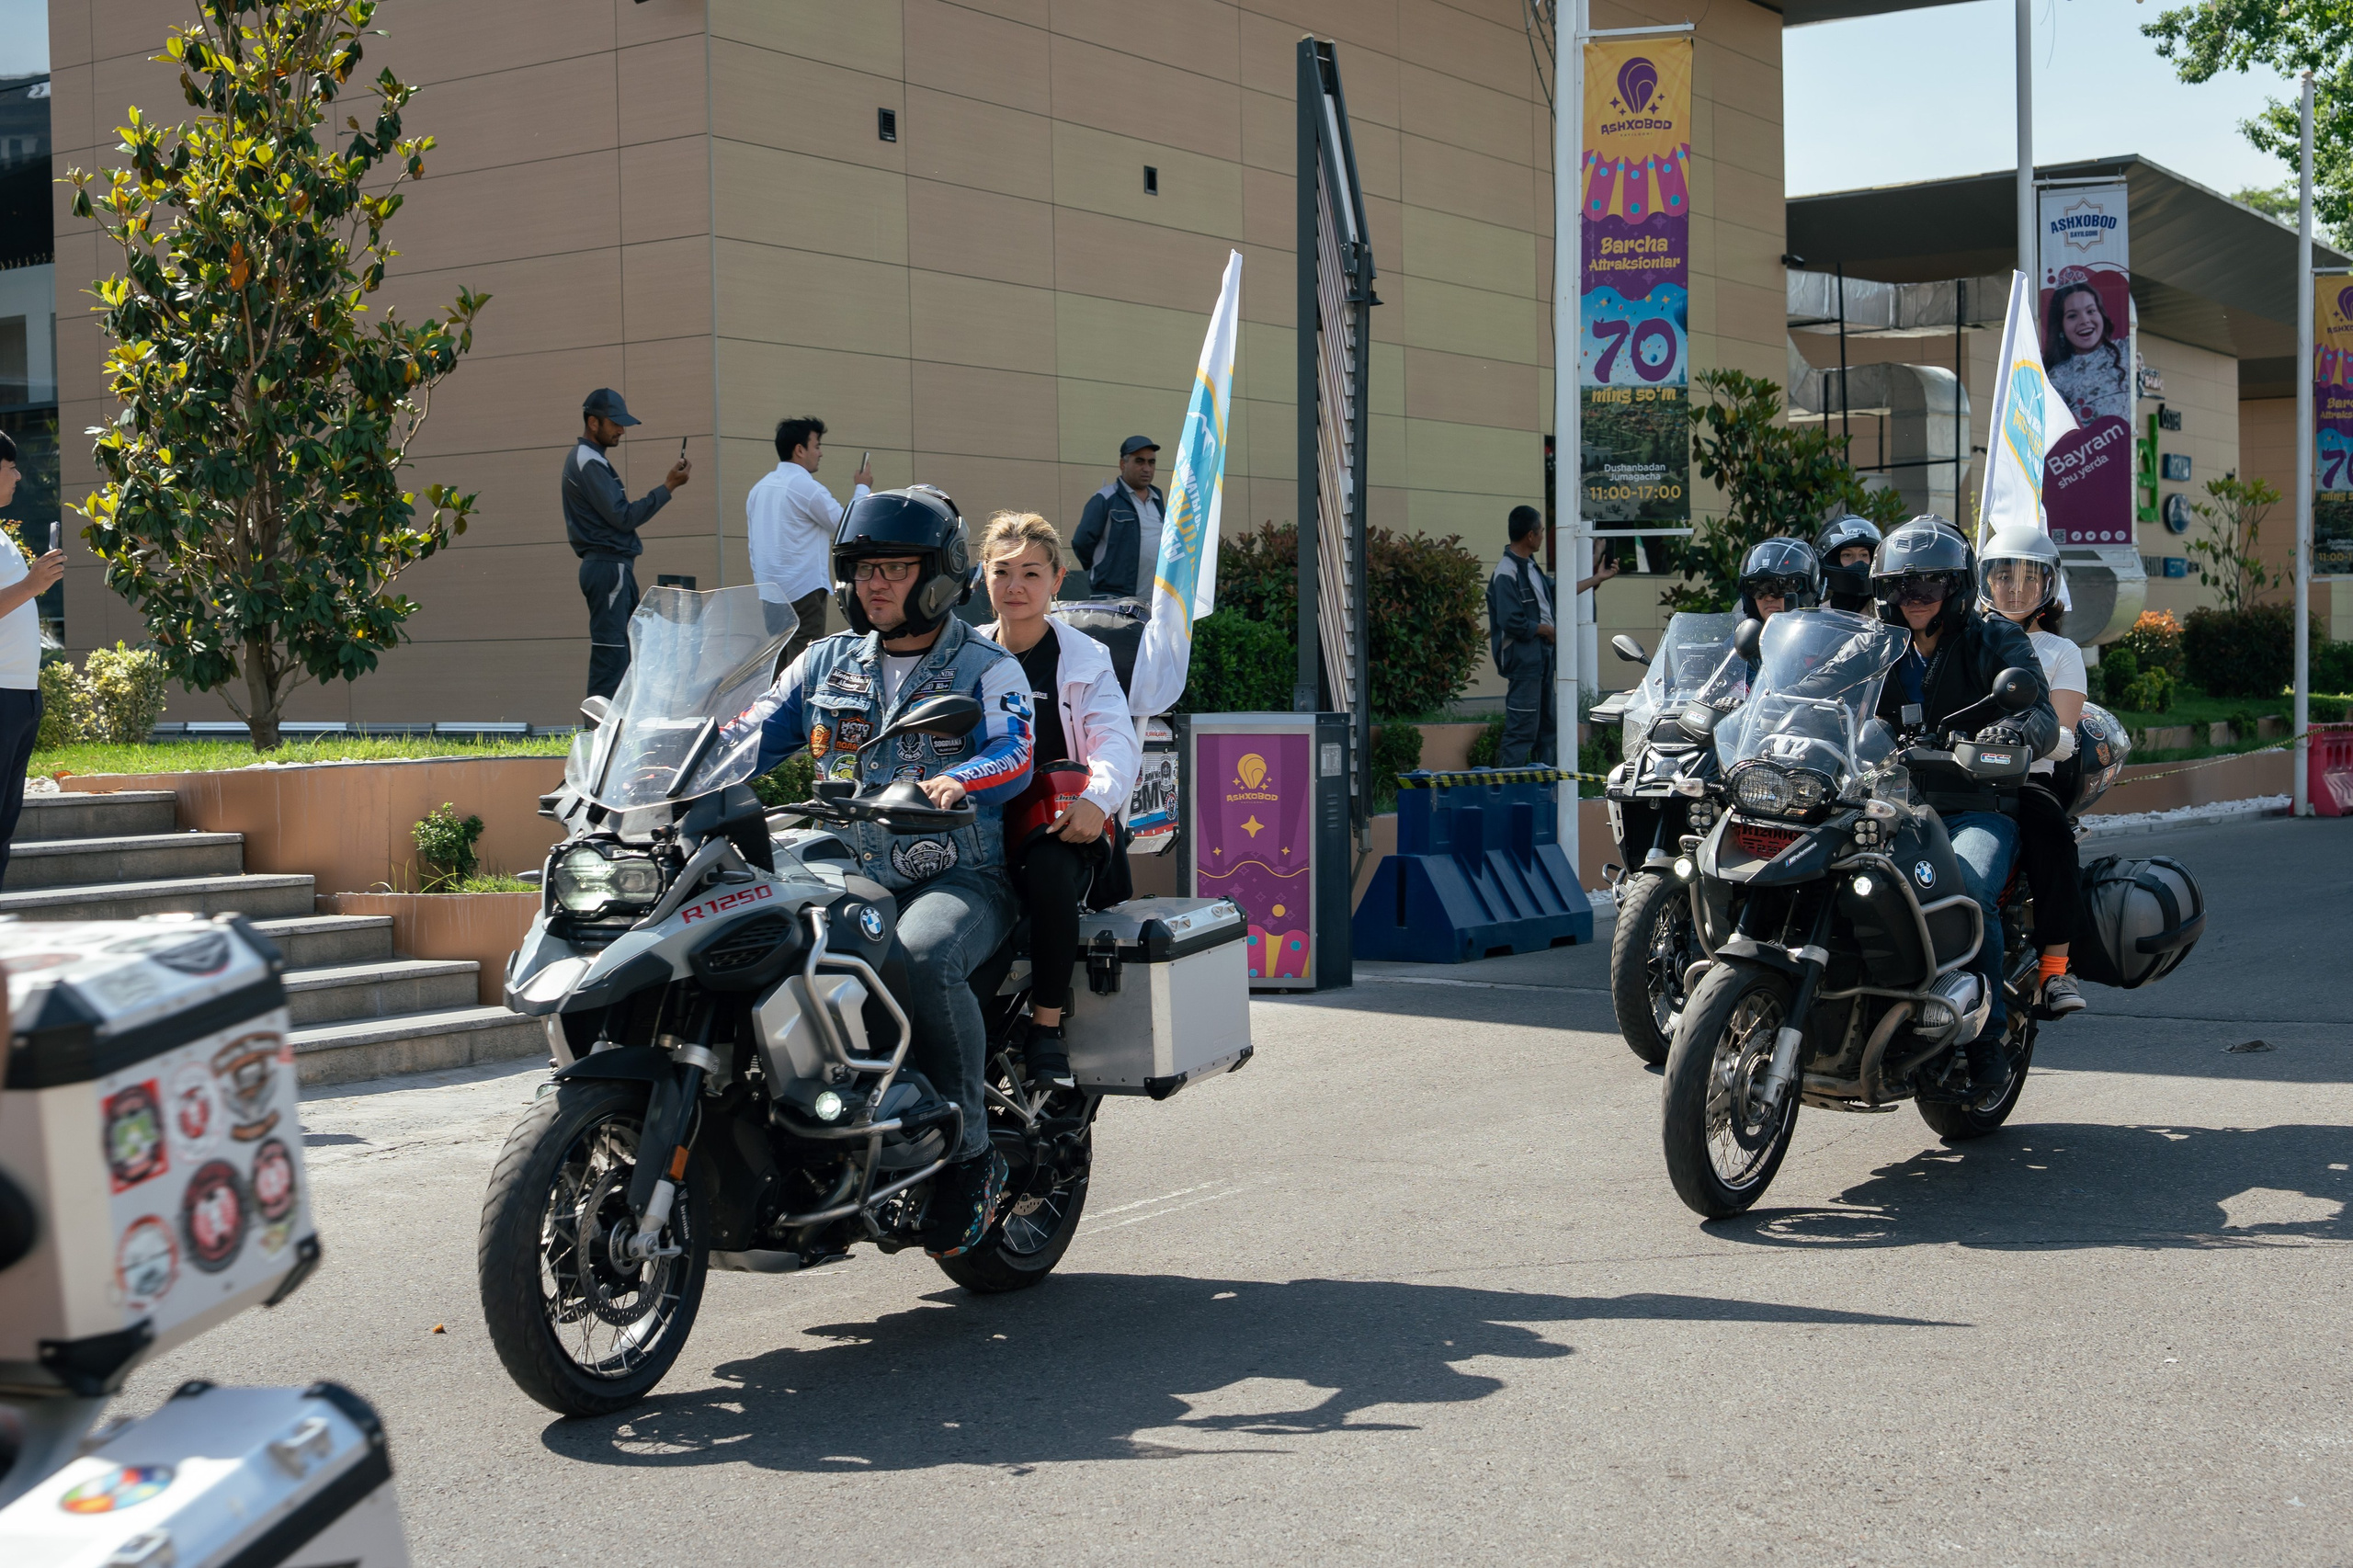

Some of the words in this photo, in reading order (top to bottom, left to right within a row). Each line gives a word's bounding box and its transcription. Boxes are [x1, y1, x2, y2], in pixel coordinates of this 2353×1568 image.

[1600, 118, 1673, 136] ASHXOBOD
[2050, 214, 2118, 234] ASHXOBOD
[1600, 234, 1669, 256] Barcha
[1588, 256, 1681, 272] Attraksionlar
[1591, 317, 1677, 383] 70
[1591, 387, 1631, 404] ming
[2047, 424, 2125, 476] Bayram
[1604, 463, 1666, 472] Dushanbadan
[2058, 472, 2079, 489] shu
[2077, 454, 2110, 479] yerda
[1609, 472, 1662, 483] Jumagacha
[1589, 484, 1682, 500] 11:00-17:00
[933, 739, 963, 748] SOGDIANA
[1980, 752, 2012, 765] GS
[957, 753, 1019, 785] Motorrad
[1742, 824, 1803, 842] R1200G
